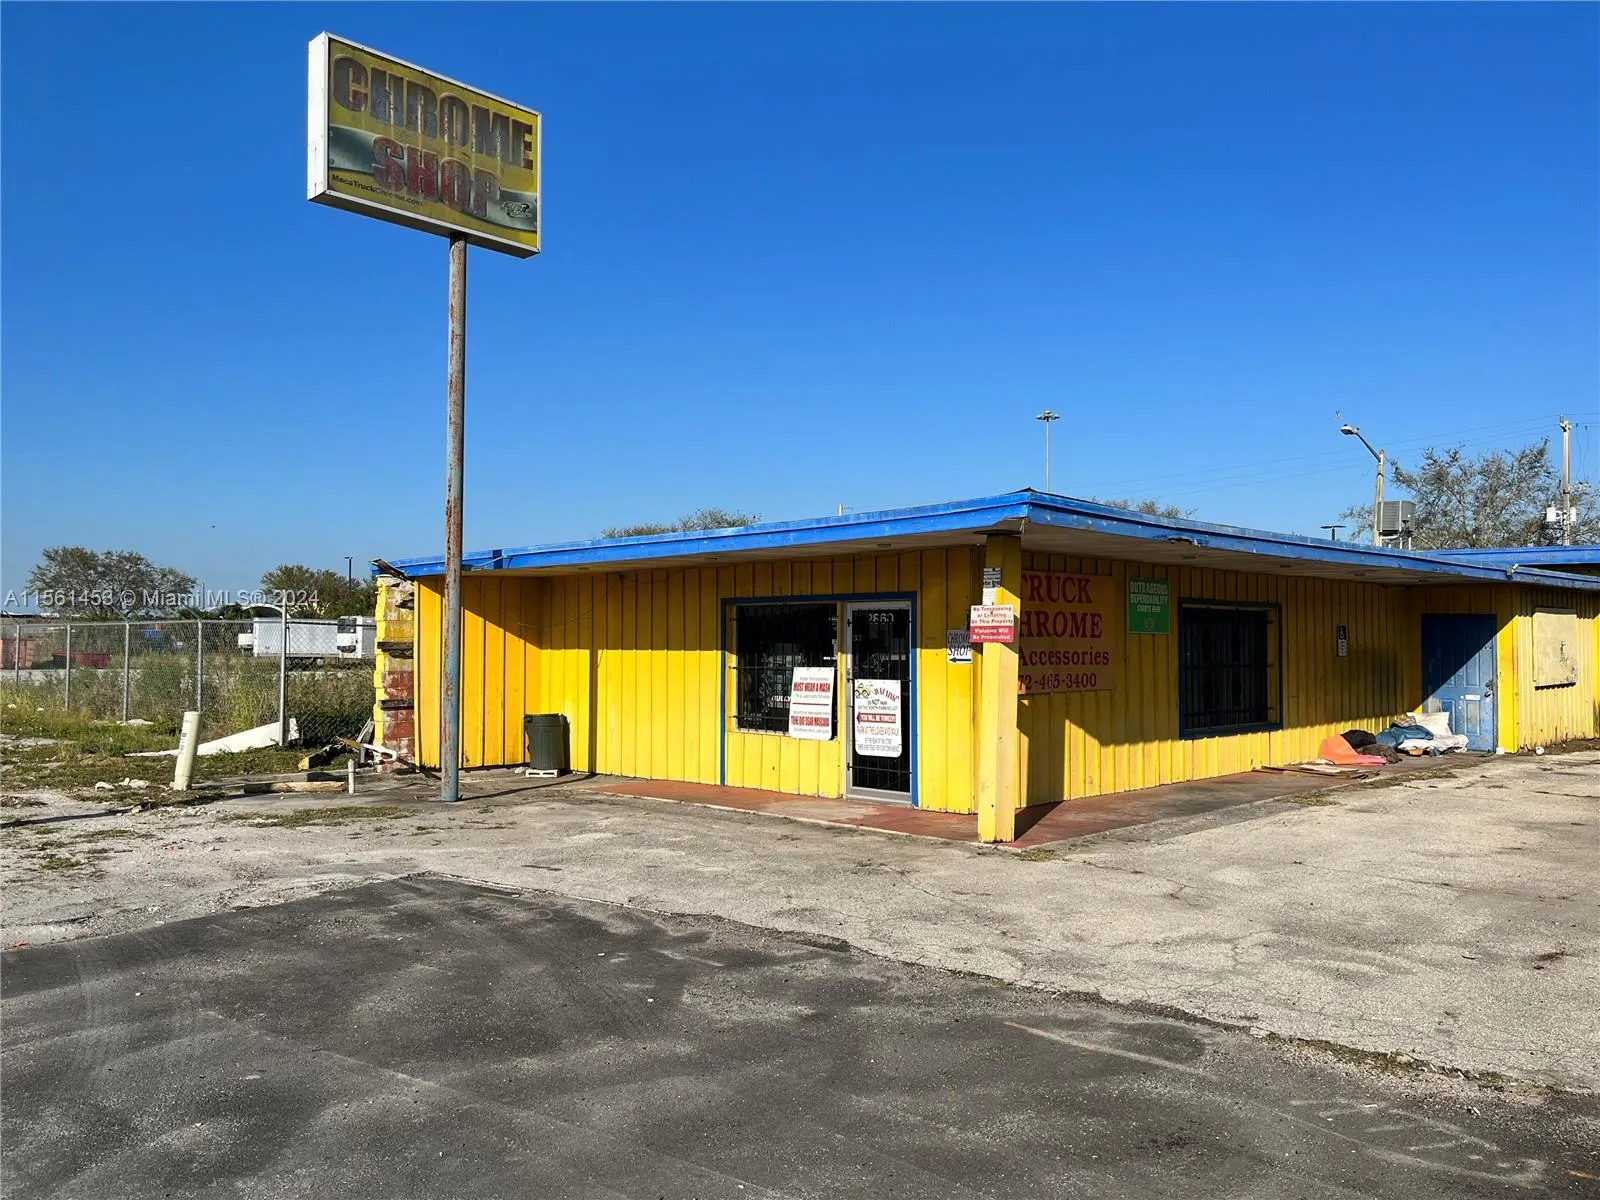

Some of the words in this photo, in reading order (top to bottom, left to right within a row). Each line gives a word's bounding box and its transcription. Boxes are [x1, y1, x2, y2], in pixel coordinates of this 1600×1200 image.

[332, 54, 533, 170] CHROME
[371, 135, 501, 218] SHOP
[1130, 581, 1168, 595] OUTRAGEOUS
[1019, 610, 1103, 638] HROME
[947, 644, 971, 657] SHOP
[1018, 672, 1097, 691] 72-465-3400
